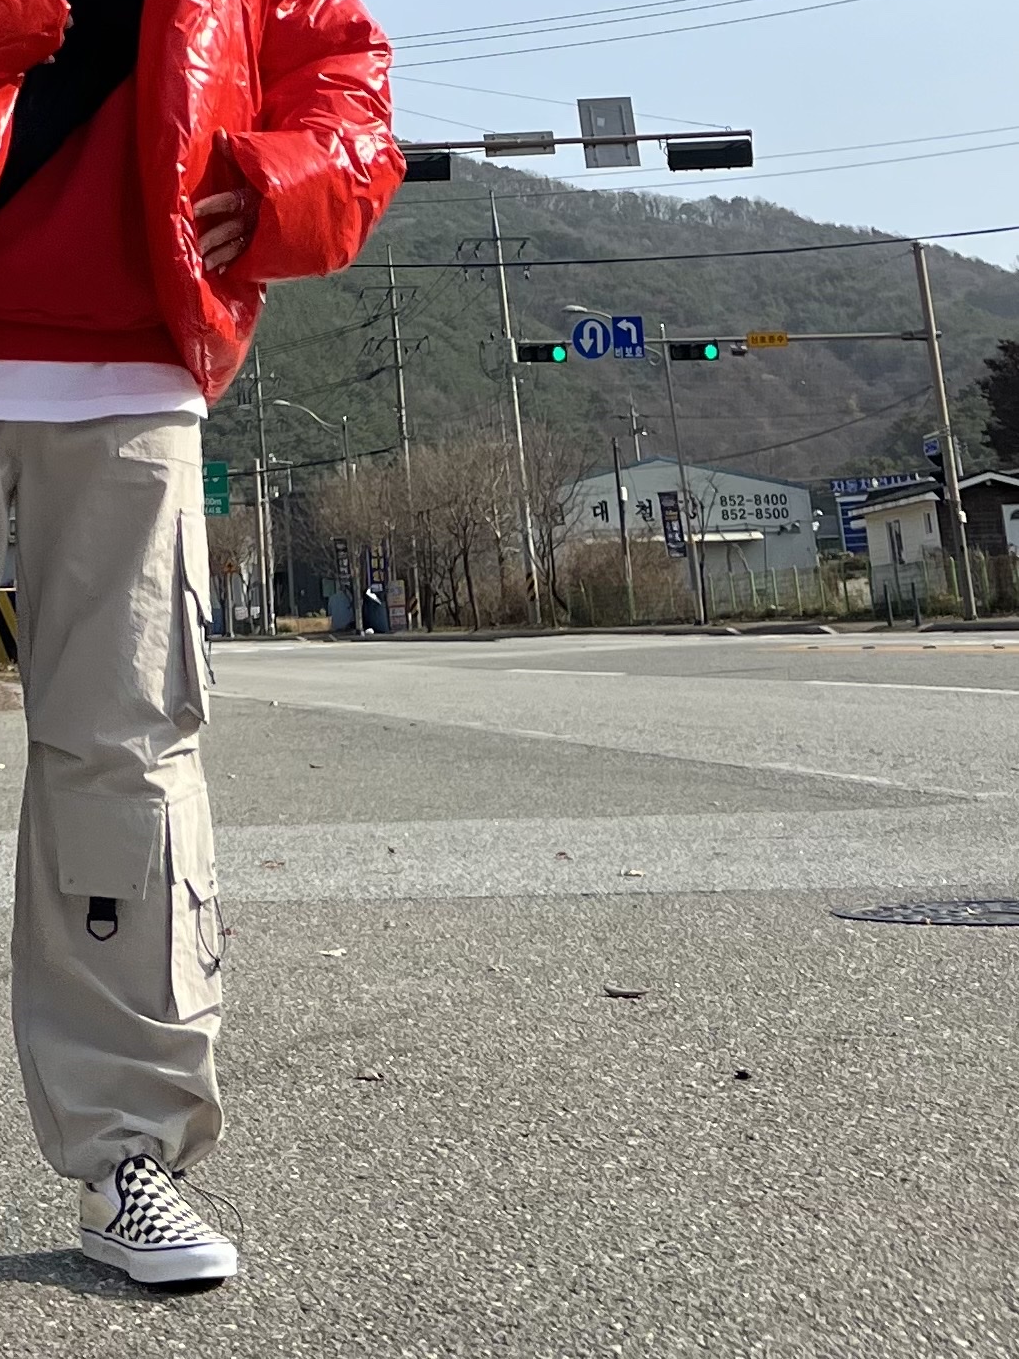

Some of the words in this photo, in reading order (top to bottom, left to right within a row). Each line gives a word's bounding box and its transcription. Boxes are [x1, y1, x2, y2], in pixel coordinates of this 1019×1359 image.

[614, 346, 644, 358] 비보호
[719, 493, 788, 507] 852-8400
[721, 507, 789, 521] 852-8500
